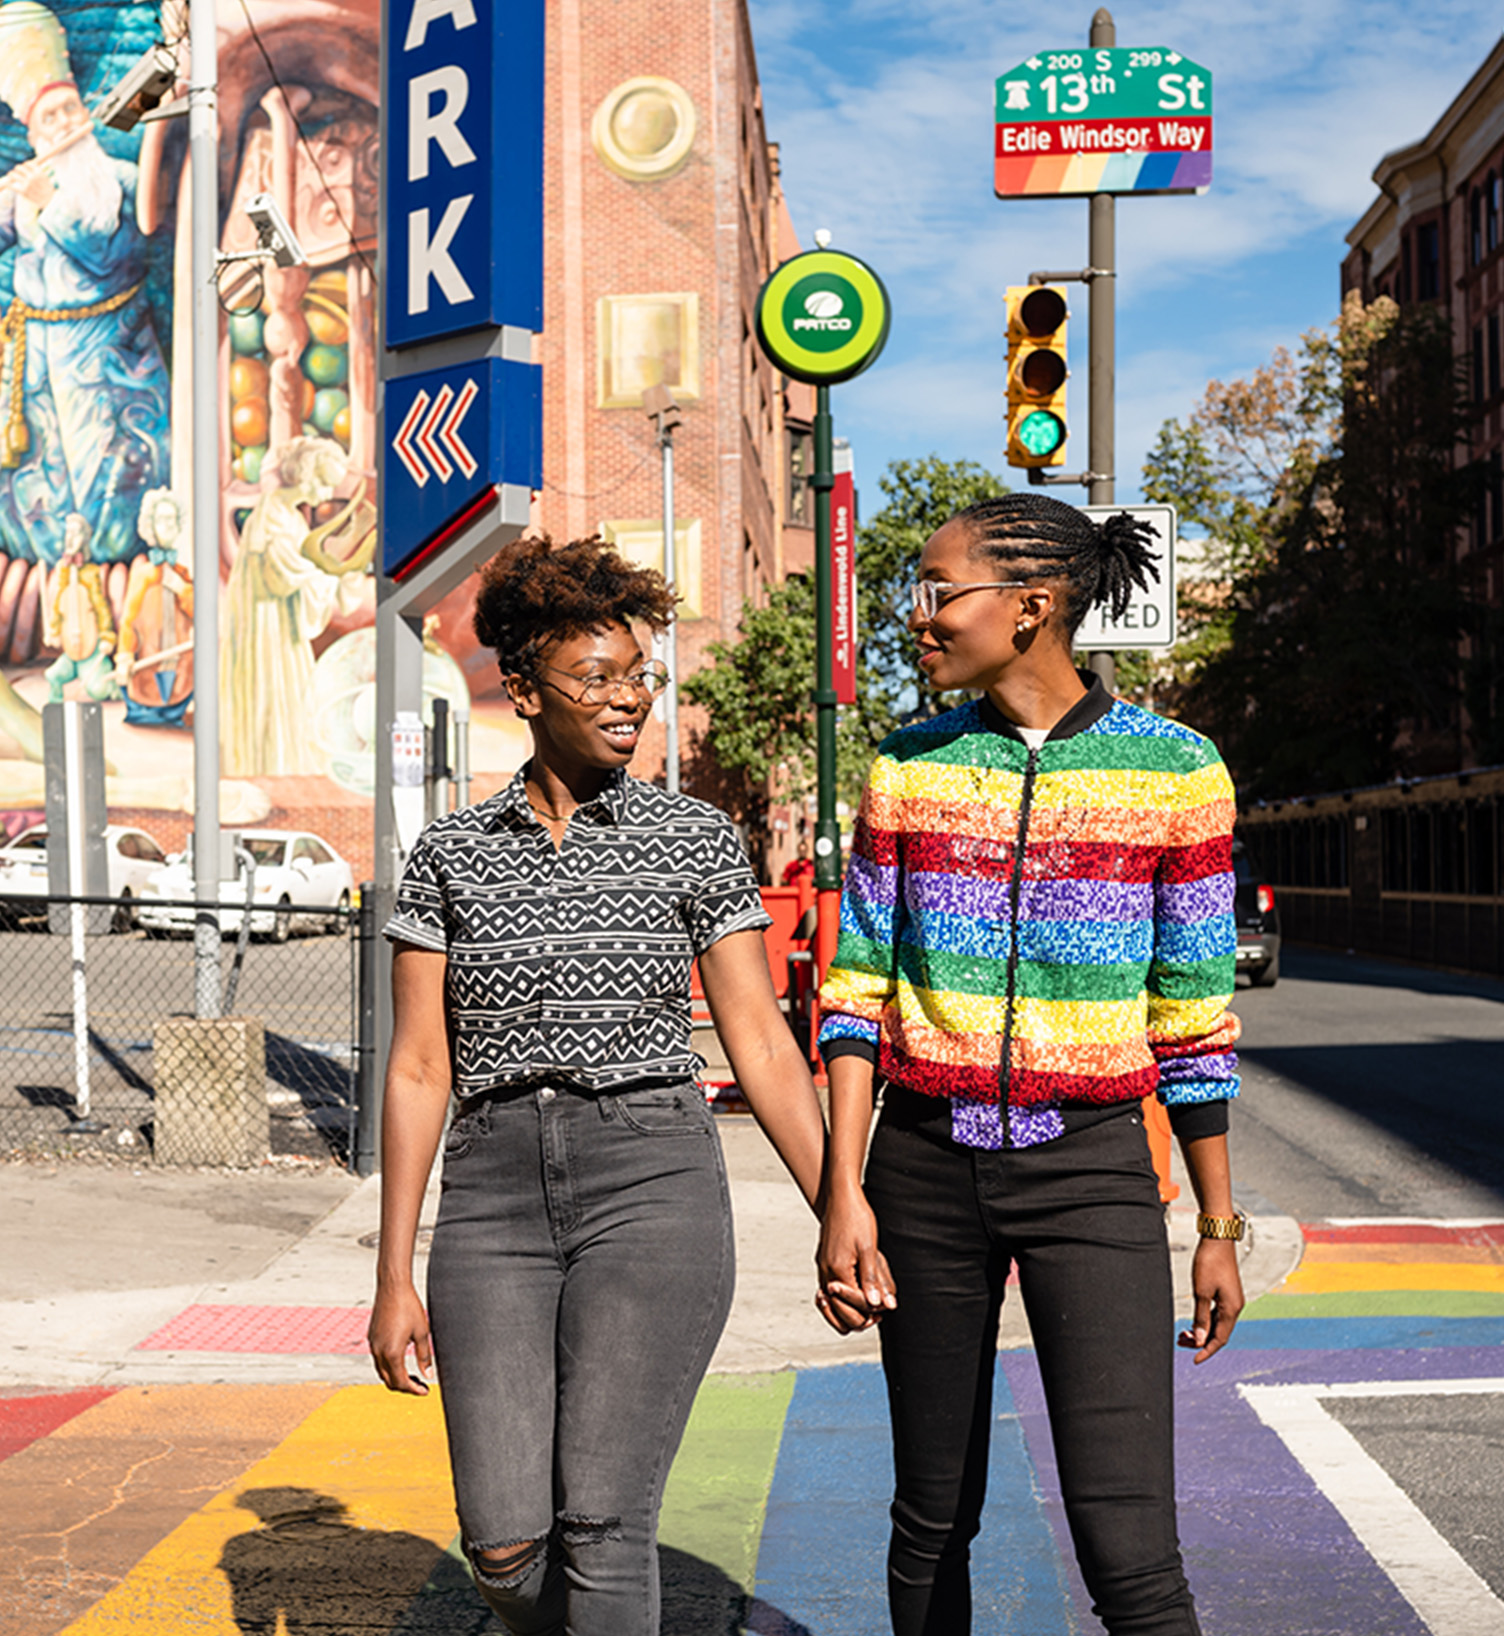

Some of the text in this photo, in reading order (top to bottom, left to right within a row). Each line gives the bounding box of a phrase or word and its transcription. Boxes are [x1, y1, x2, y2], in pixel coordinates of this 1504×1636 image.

[1047, 50, 1162, 71] 200 S 299
[1039, 73, 1205, 114] 13th St
[1002, 122, 1205, 152] Edie Windsor Way
[793, 318, 852, 331] PATCO
[834, 506, 848, 543] Line
[835, 545, 849, 640] Lindenwold
[1101, 604, 1160, 629] RED
